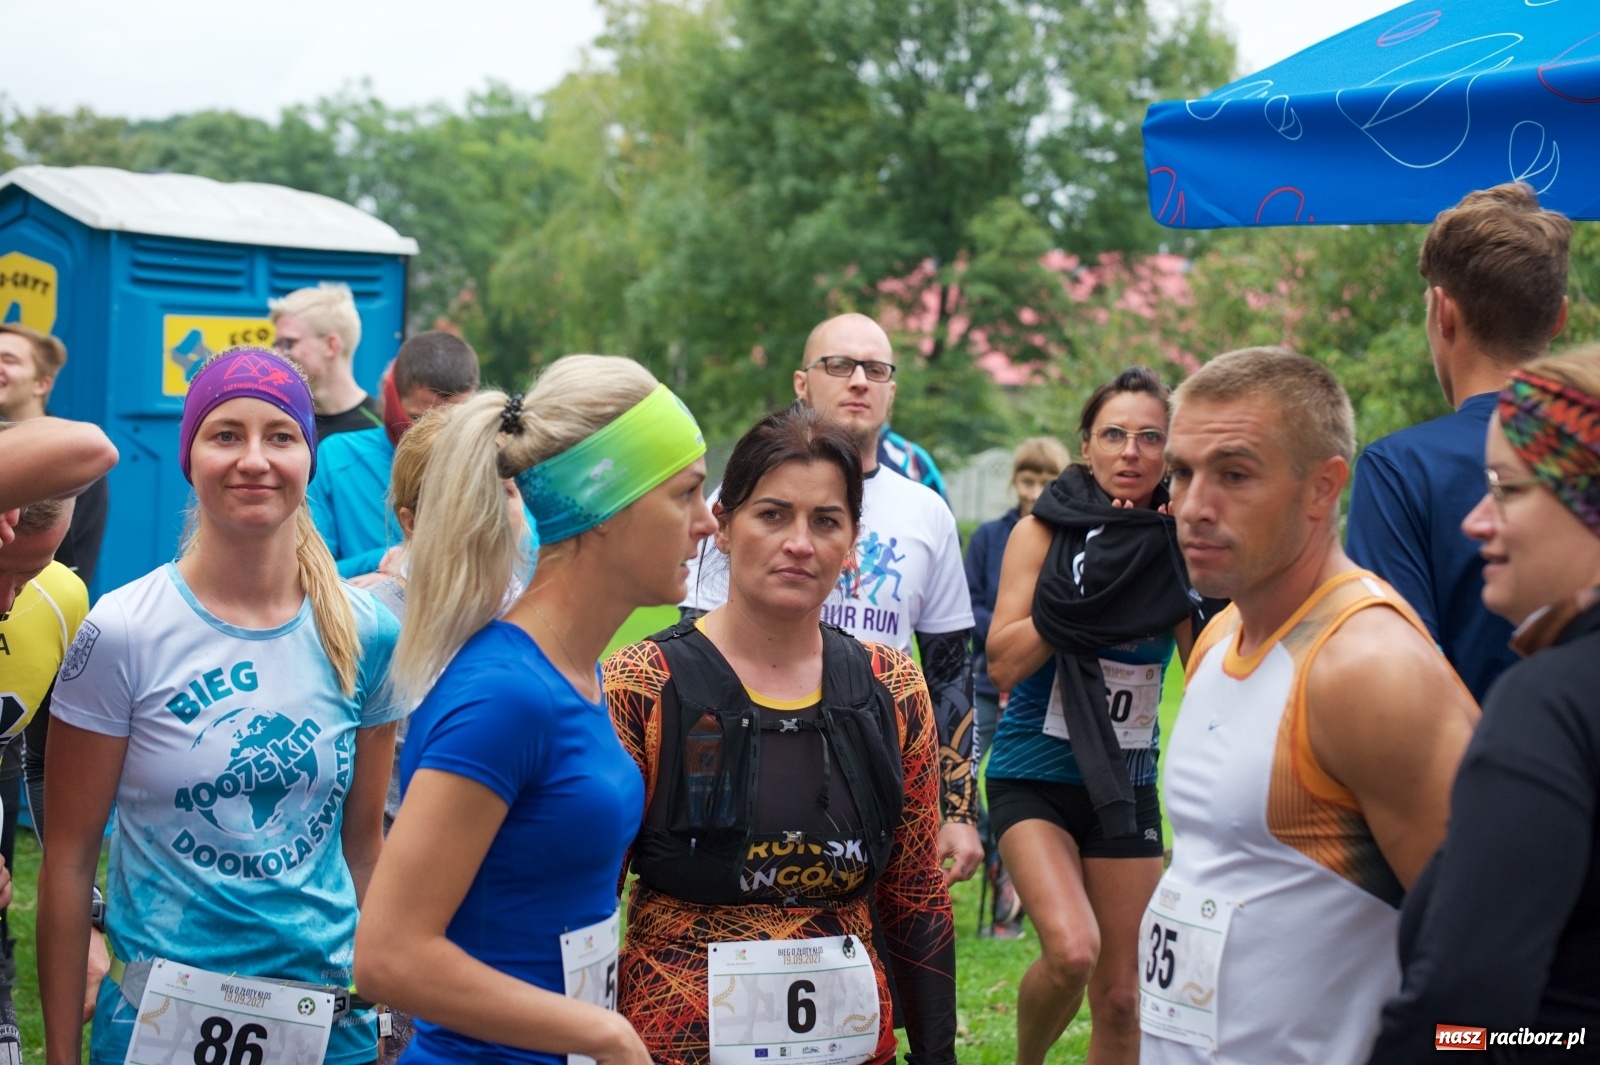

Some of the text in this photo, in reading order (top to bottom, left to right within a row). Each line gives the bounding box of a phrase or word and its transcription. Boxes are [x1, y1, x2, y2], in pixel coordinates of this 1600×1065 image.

[863, 608, 899, 636] RUN
[165, 660, 259, 725] BIEG
[307, 732, 350, 843] ŚWIATA
[171, 828, 313, 878] DOOKOŁA
[777, 948, 791, 956] BIEG
[783, 954, 821, 965] 19.09.2021
[1146, 922, 1178, 989] 35
[220, 983, 235, 994] BIEG
[224, 991, 266, 1009] 19.09.2021
[787, 979, 817, 1034] 6
[193, 1015, 268, 1065] 86
